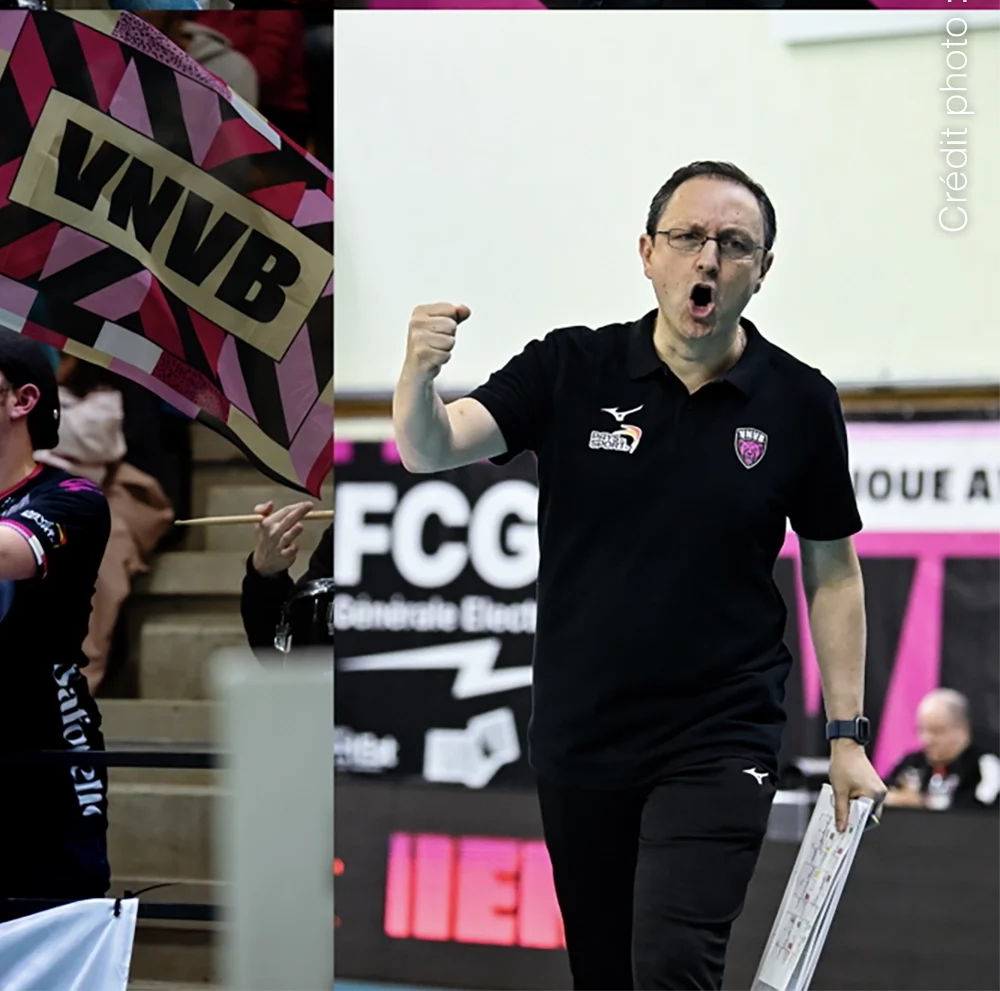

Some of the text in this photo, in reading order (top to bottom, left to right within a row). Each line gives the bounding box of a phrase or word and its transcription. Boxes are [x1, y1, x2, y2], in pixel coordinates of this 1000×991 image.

[54, 119, 301, 323] VNVB
[334, 480, 540, 589] FCG
[854, 468, 953, 502] OUE
